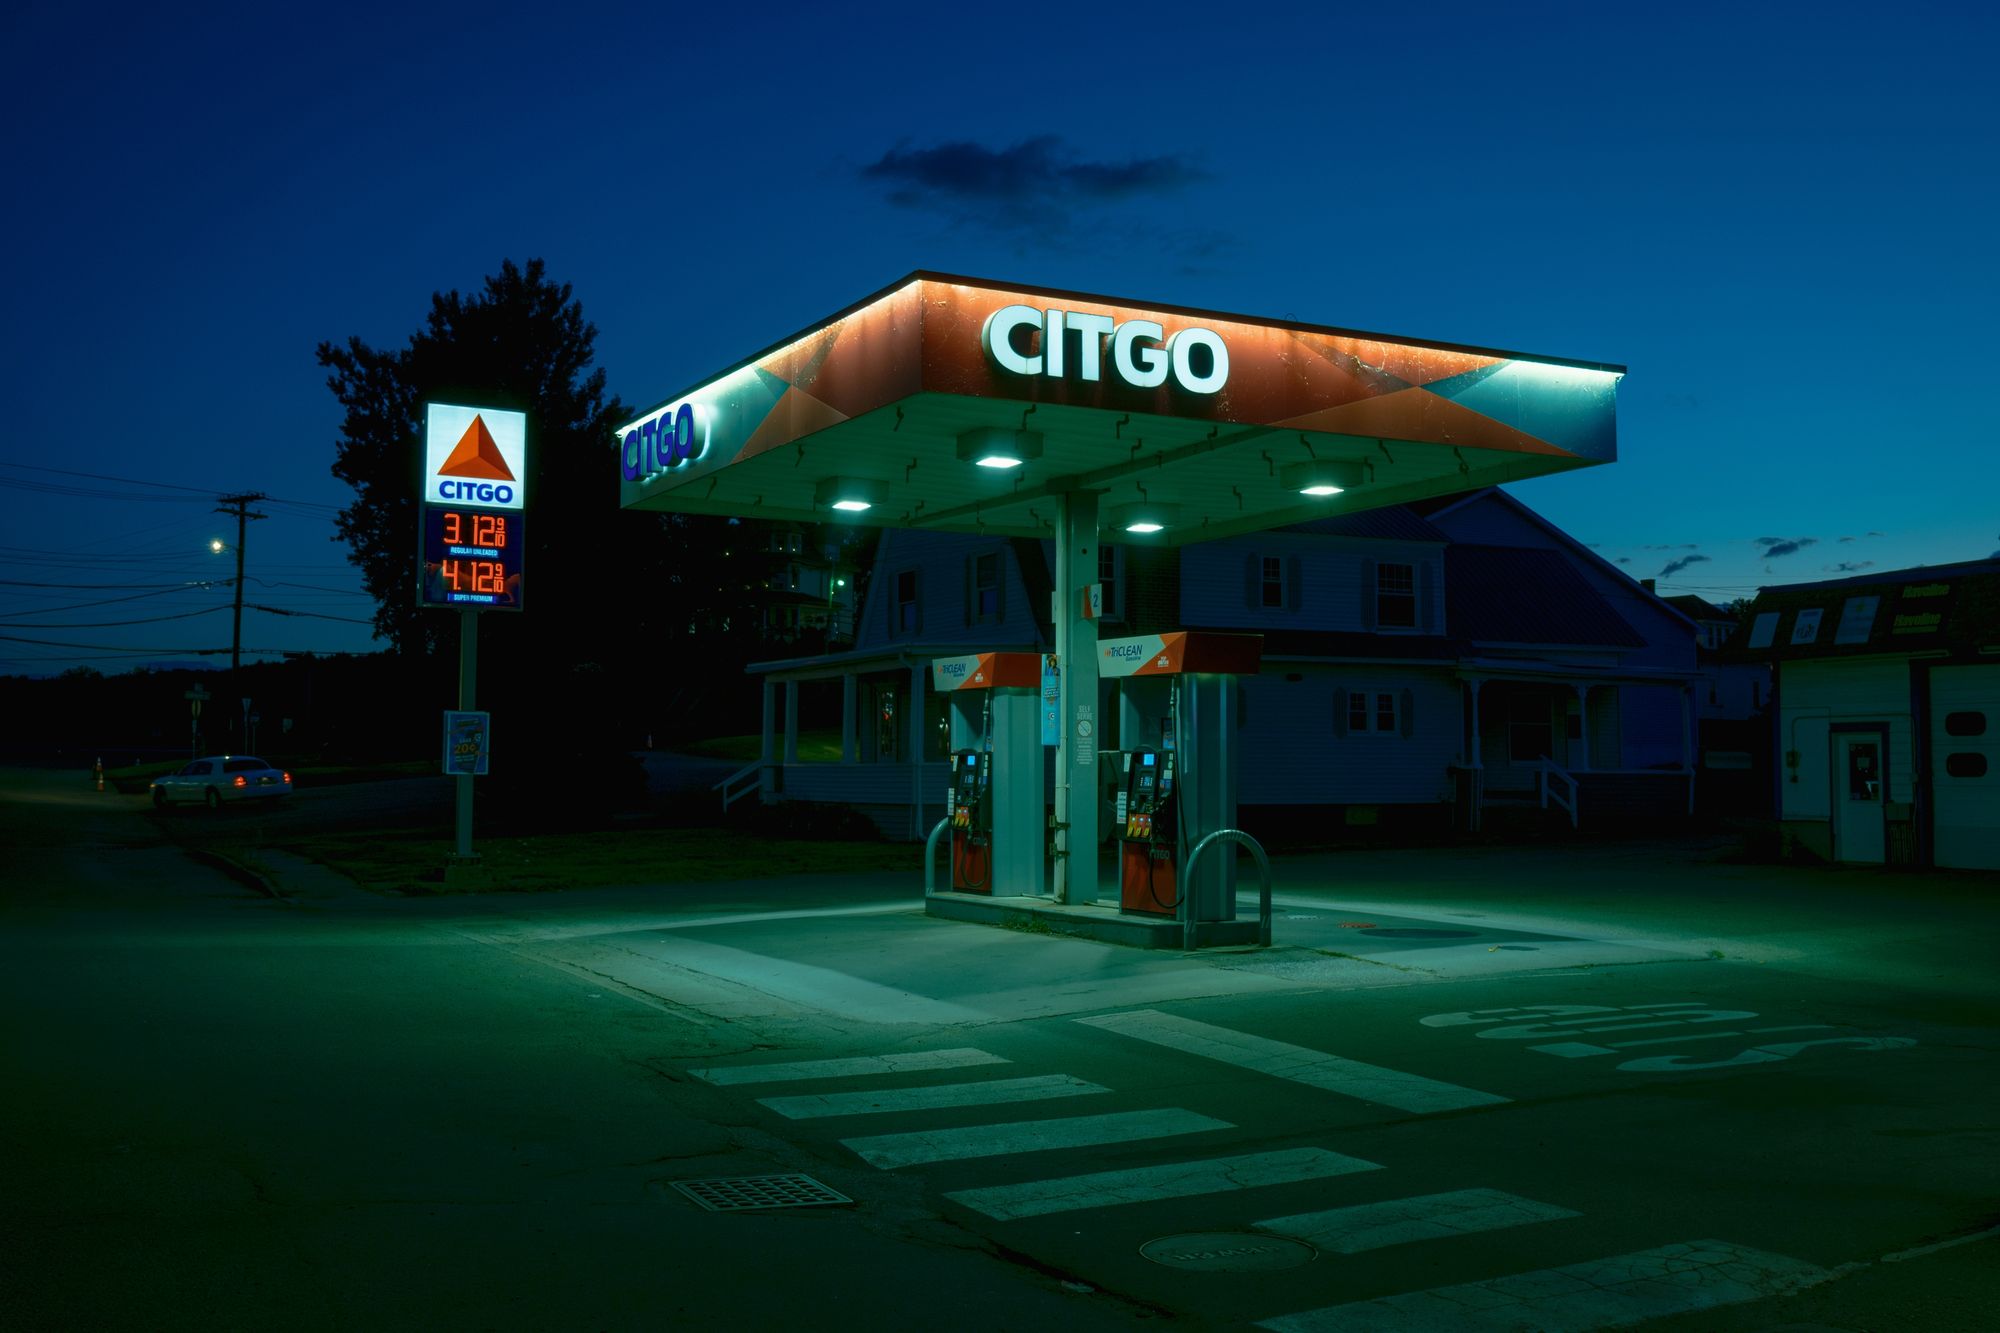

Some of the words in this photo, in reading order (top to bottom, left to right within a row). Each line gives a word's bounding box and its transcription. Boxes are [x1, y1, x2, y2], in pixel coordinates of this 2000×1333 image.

[984, 305, 1230, 394] CITGO
[622, 402, 696, 482] CITGO
[439, 482, 513, 504] CITGO
[450, 546, 472, 555] REGULAR
[473, 548, 498, 557] UNLEADED
[454, 594, 470, 602] SUPER
[470, 595, 493, 603] PREMIUM
[1093, 594, 1098, 607] 2
[1110, 645, 1143, 657] TriCLEAN
[1420, 1002, 1918, 1072] STOP
